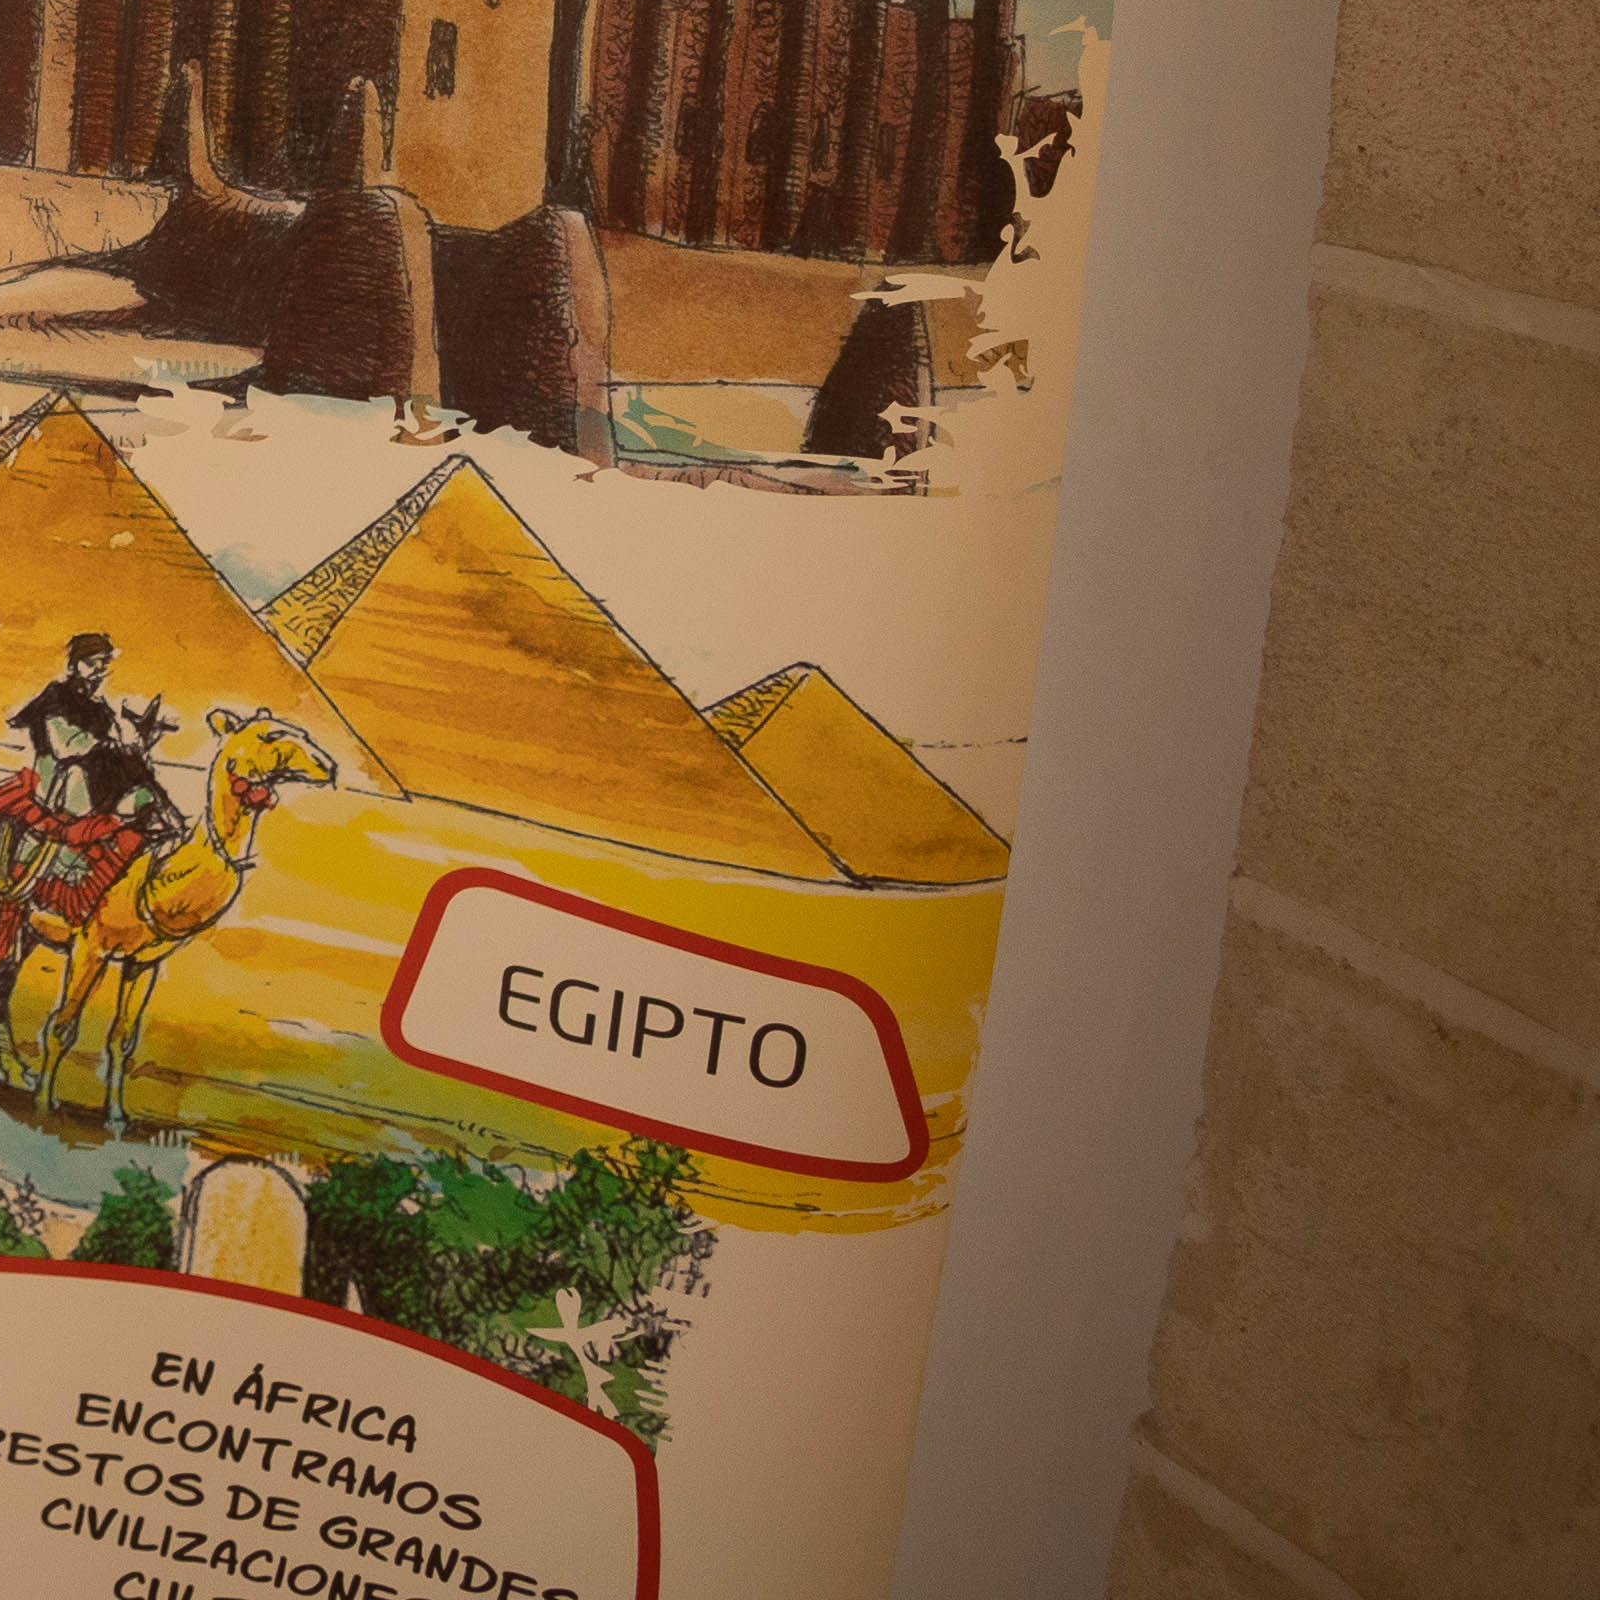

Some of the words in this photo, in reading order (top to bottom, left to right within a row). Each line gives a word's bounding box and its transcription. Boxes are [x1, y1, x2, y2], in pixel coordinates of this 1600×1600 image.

[498, 964, 808, 1090] EGIPTO
[150, 1351, 216, 1397] EN
[232, 1362, 418, 1454] ÁFRICA
[75, 1392, 483, 1532] ENCONTRAMOS
[225, 1484, 301, 1532] DE
